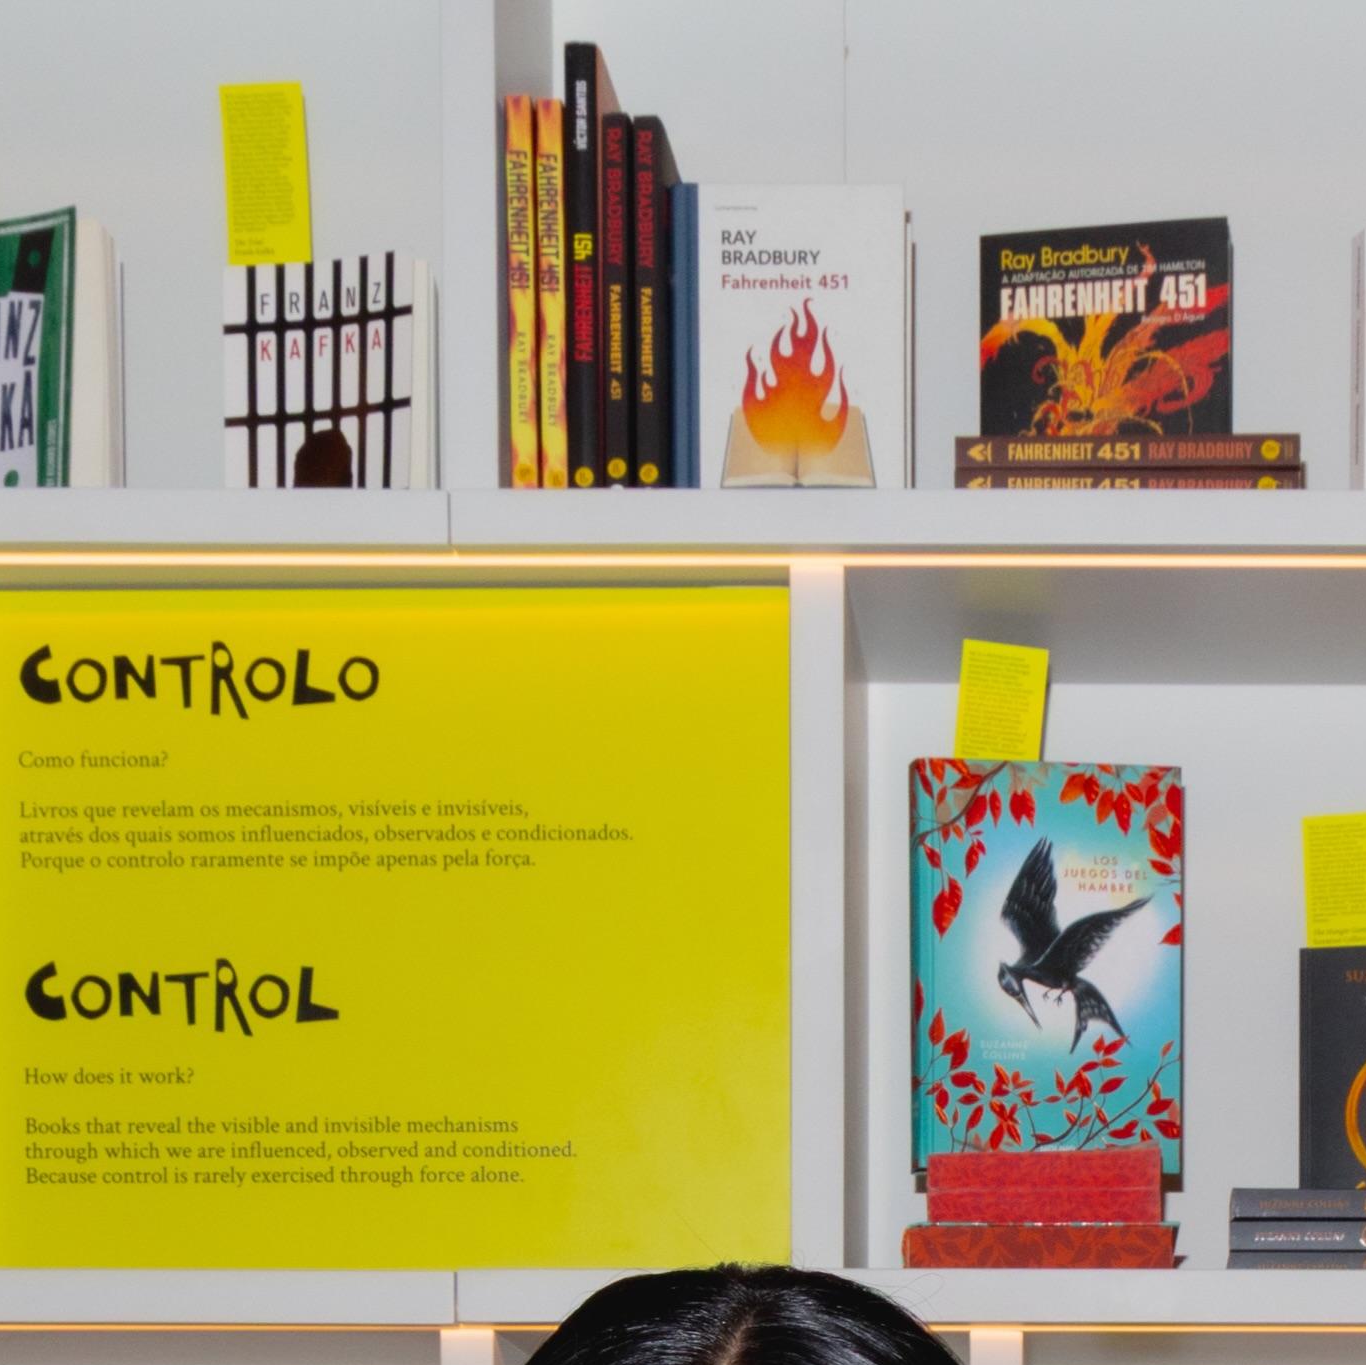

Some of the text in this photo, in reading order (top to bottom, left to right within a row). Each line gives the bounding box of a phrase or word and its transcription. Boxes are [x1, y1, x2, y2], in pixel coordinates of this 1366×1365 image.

[575, 80, 586, 115] SANTOS
[720, 230, 757, 245] RAY
[720, 249, 821, 265] BRADBURY
[1001, 244, 1129, 272] Ray Bradbury
[720, 274, 849, 290] Fahrenheit 451
[574, 232, 594, 361] FAHRENHEIT 451
[1000, 273, 1207, 321] FAHRENHEIT 451
[259, 328, 383, 361] KAFKA
[1007, 442, 1253, 462] FAHRENHEIT 451 RAY BRADBURY
[17, 639, 381, 722] CONTROLO
[17, 749, 169, 769] Como funciona?
[19, 799, 529, 824] Livros que revelam os mecanismos, visíveis e invisíveis,
[18, 823, 634, 849] através dos quais somos influenciados, observados e condicionados.
[20, 847, 536, 875] Porque o controlo raramente se impõe apenas pela força.
[23, 956, 341, 1039] CONTROL
[24, 1065, 195, 1086] How does it work?
[24, 1115, 519, 1136] Books that reveal the visible and invisible mechanisms
[24, 1139, 578, 1165] through which we are influenced, observed and conditioned.
[25, 1164, 525, 1189] Because control is rarely exercised through force alone.
